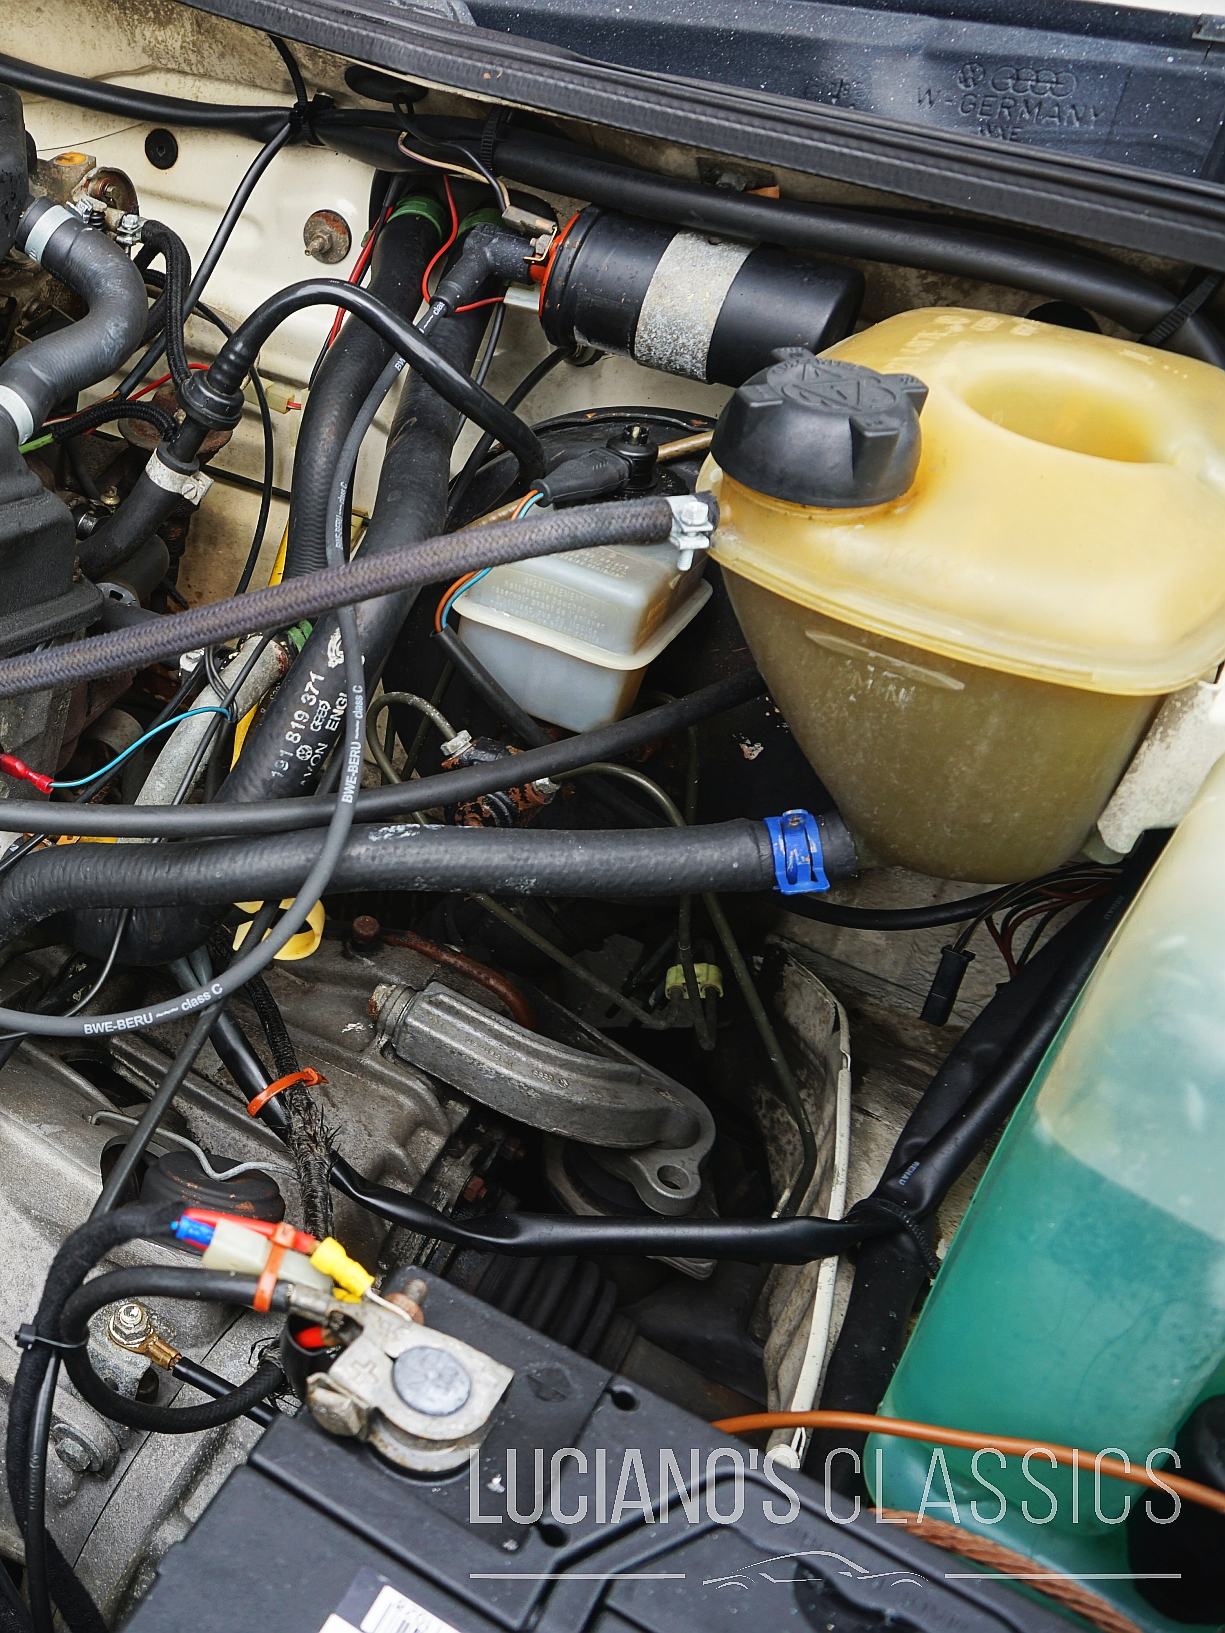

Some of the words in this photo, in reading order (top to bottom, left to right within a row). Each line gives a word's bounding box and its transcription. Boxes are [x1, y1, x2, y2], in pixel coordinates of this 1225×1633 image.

[524, 577, 585, 602] AVERTISSEMENT
[352, 685, 363, 694] C
[352, 694, 364, 719] class
[271, 749, 294, 777] 191
[285, 710, 310, 743] 819
[301, 671, 325, 706] 371
[341, 741, 361, 803] BWE-BERU
[1103, 895, 1125, 921] REHAU
[84, 1012, 153, 1035] BWE-BERU
[181, 990, 211, 1011] class
[211, 983, 223, 995] C
[898, 1161, 920, 1186] REHAU
